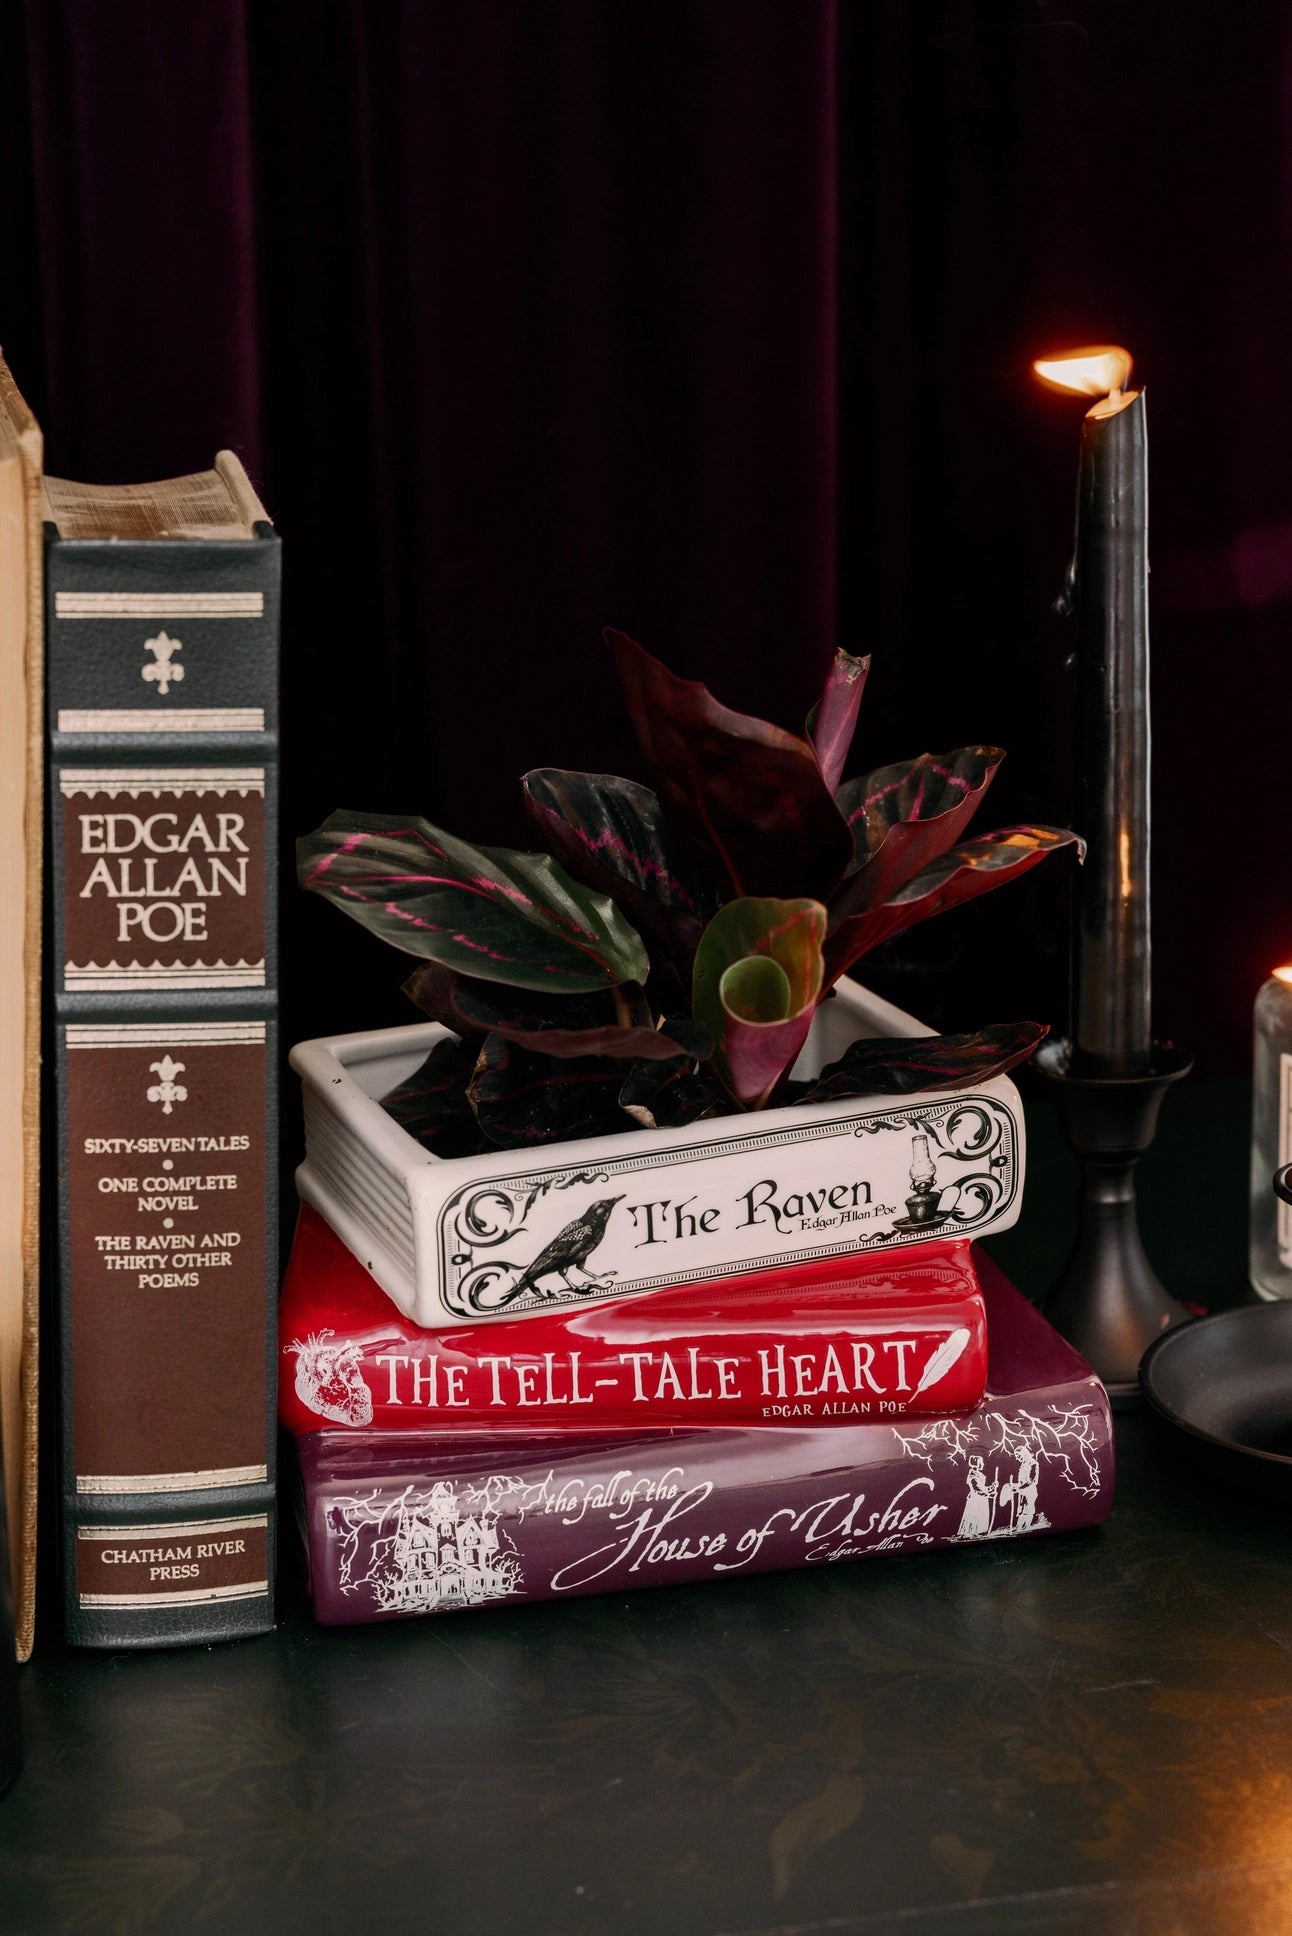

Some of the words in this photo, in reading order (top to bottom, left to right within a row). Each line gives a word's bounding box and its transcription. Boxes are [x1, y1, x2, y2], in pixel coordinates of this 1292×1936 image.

[78, 813, 250, 854] EDGAR
[79, 857, 250, 898] ALLAN
[116, 901, 208, 942] POE
[84, 1137, 196, 1154] SIXTY-SEVEN
[197, 1135, 250, 1151] TALES
[98, 1177, 139, 1193] ONE
[142, 1175, 238, 1192] COMPLETE
[137, 1196, 199, 1211] NOVEL
[626, 1195, 721, 1249] The
[735, 1179, 873, 1235] Raven
[800, 1214, 838, 1232] Edgar
[838, 1208, 871, 1227] Allan
[873, 1203, 897, 1220] Poe
[95, 1236, 131, 1251] THE
[135, 1235, 195, 1250] RAVEN
[200, 1232, 241, 1248] AND
[104, 1255, 168, 1270] THIRTY
[172, 1252, 232, 1268] OTHER
[138, 1272, 199, 1289] POEMS
[375, 1353, 471, 1408] THE
[757, 1339, 918, 1399] HEART
[762, 1402, 815, 1418] EDGAR
[822, 1402, 871, 1416] ALLAN
[879, 1400, 907, 1413] POE
[545, 1478, 584, 1514] the
[562, 1470, 632, 1526] fall
[609, 1478, 650, 1520] of
[645, 1467, 684, 1502] the
[550, 1481, 727, 1591] House
[713, 1508, 796, 1571] of
[790, 1477, 949, 1543] Usher
[101, 1546, 192, 1564] CHATHAM
[197, 1539, 246, 1559] RIVER
[149, 1563, 200, 1581] PRESS
